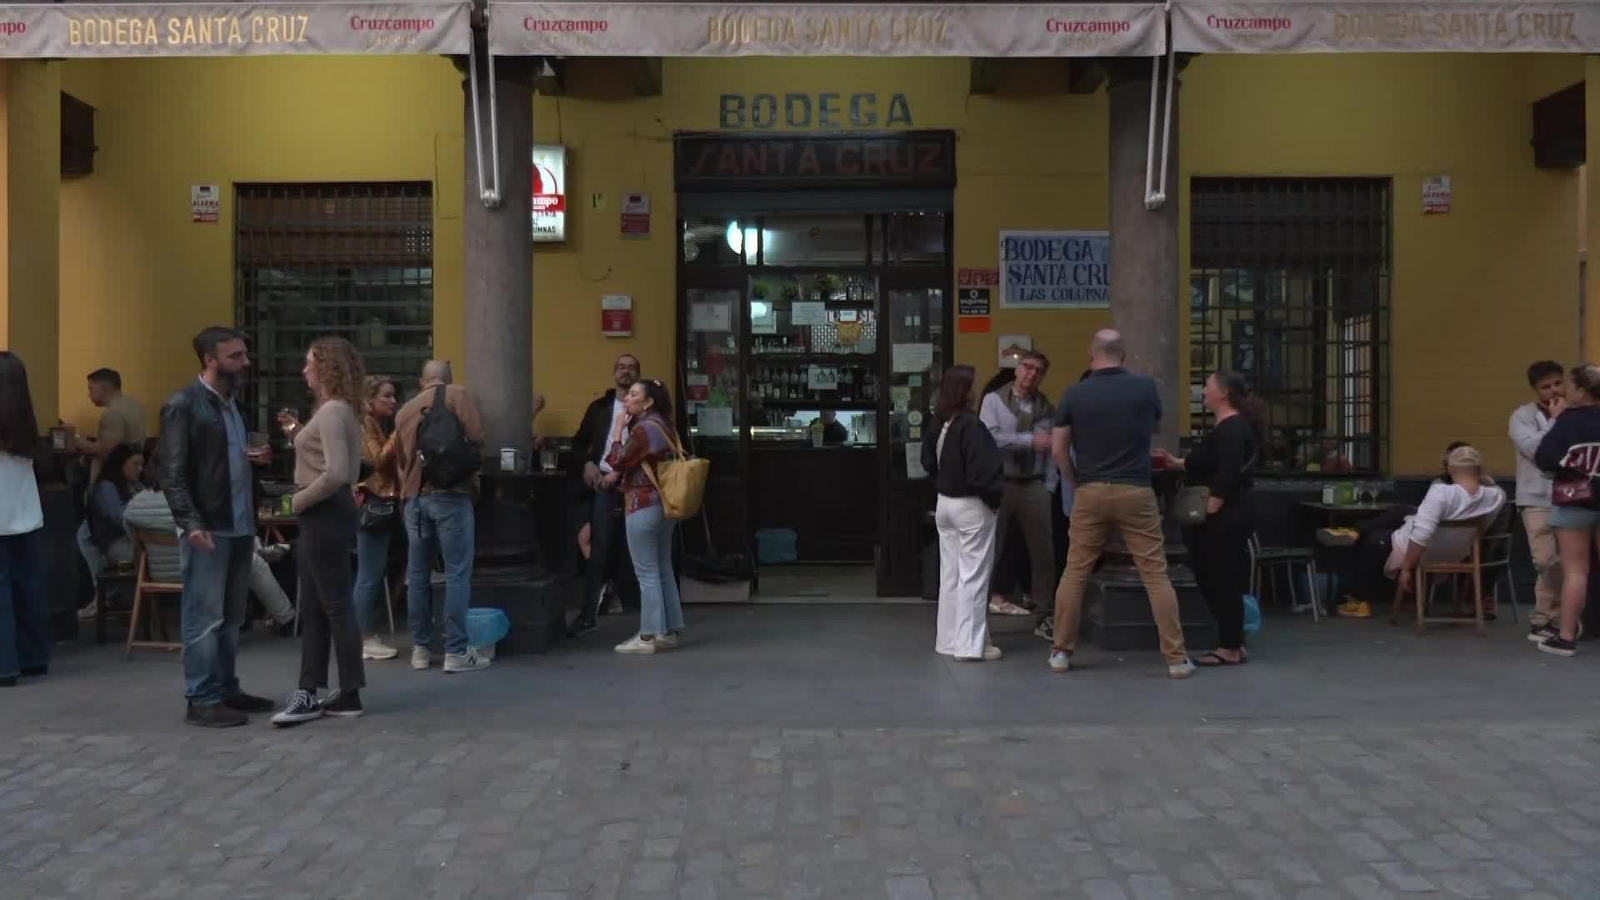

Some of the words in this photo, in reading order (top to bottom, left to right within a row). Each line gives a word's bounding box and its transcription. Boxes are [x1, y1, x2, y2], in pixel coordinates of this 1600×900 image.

[68, 17, 159, 46] BODEGA
[168, 16, 242, 45] SANTA
[251, 14, 309, 43] CRUZ
[350, 15, 435, 33] Cruzcampo
[523, 16, 608, 33] Cruzcampo
[707, 16, 796, 44] BODEGA
[806, 15, 881, 42] SANTA
[892, 15, 947, 42] CRUZ
[1046, 18, 1131, 34] Cruzcampo
[1206, 13, 1292, 32] Cruzcampo
[1334, 12, 1424, 40] BODEGA
[1435, 12, 1507, 40] SANTA
[1517, 12, 1576, 40] CRUZ
[719, 93, 913, 128] BODEGA
[836, 143, 942, 175] CRUZ
[1005, 239, 1094, 262] BODEGA
[1008, 263, 1067, 286] SANTA
[1020, 288, 1046, 301] LAS
